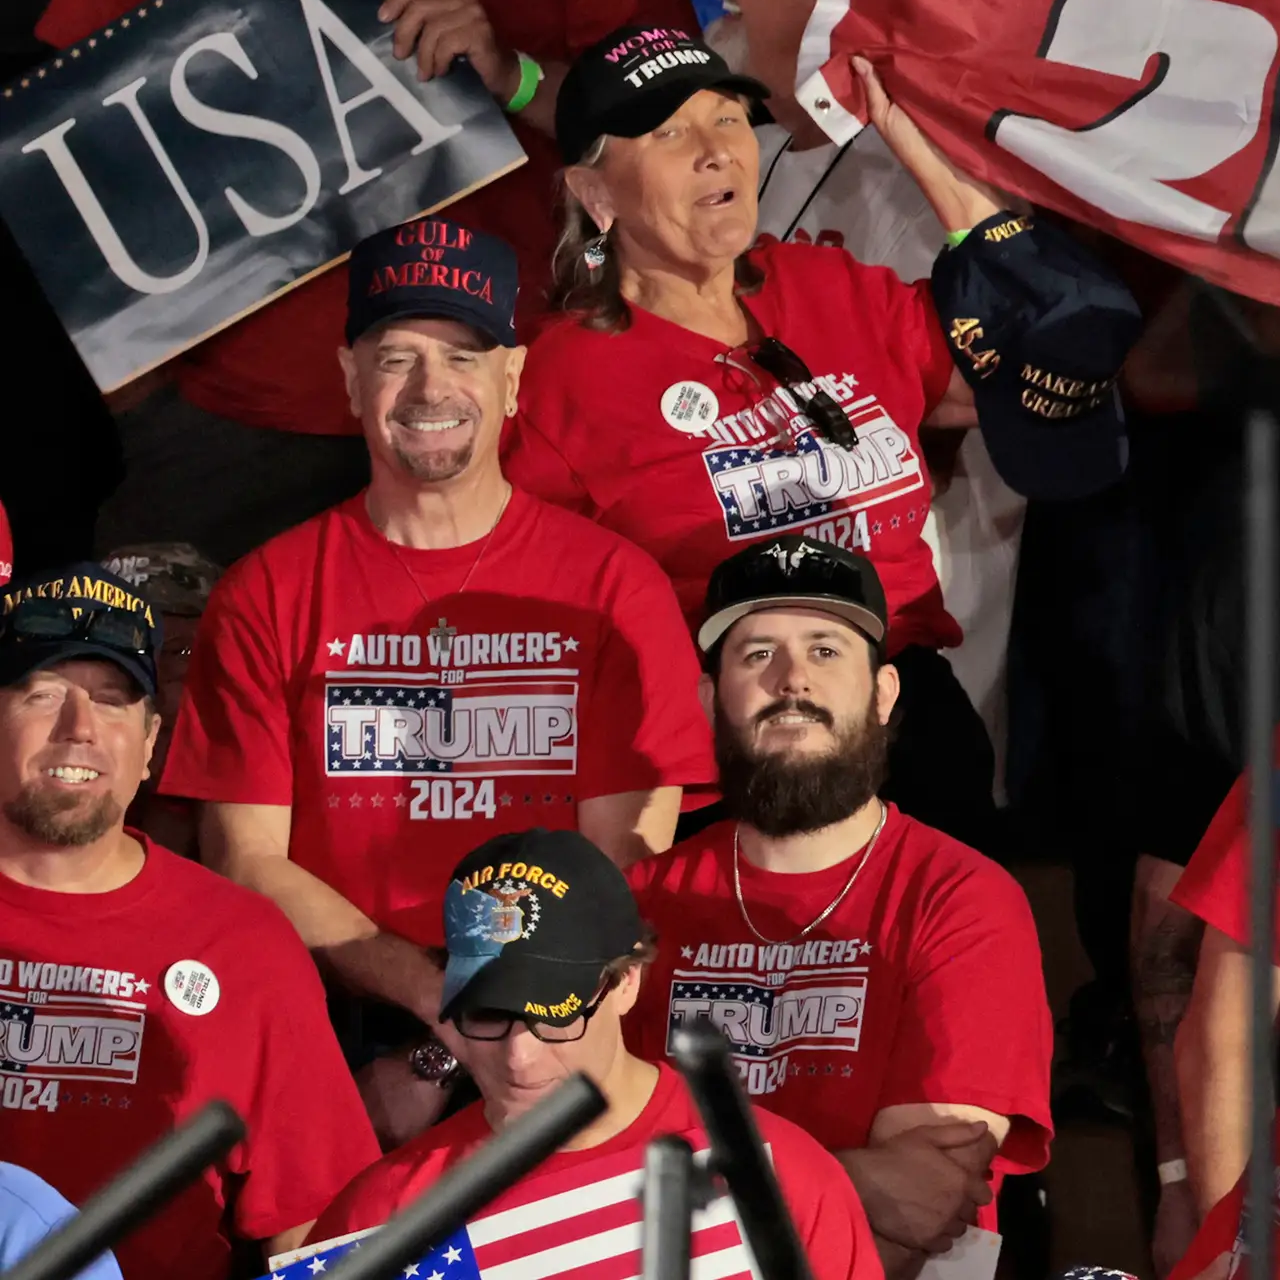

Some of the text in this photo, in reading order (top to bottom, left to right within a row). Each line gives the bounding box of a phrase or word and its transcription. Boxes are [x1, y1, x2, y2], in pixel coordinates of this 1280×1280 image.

[640, 39, 677, 57] FOR
[623, 49, 711, 88] TRUMP
[395, 221, 473, 251] GULF
[421, 246, 445, 262] OF
[367, 261, 494, 306] AMERICA
[716, 427, 906, 520] TRUMP
[3, 578, 64, 616] MAKE
[66, 575, 156, 629] AMERICA
[347, 631, 563, 668] AUTO WORKERS
[441, 670, 464, 684] FOR
[329, 705, 574, 759] TRUMP
[409, 779, 498, 821] 2024
[461, 862, 570, 899] AIR FORCE
[693, 938, 861, 971] AUTO WORKERS
[18, 961, 137, 998] WORKERS
[766, 972, 785, 986] FOR
[27, 991, 49, 1005] FOR
[524, 992, 582, 1019] AIR FORCE
